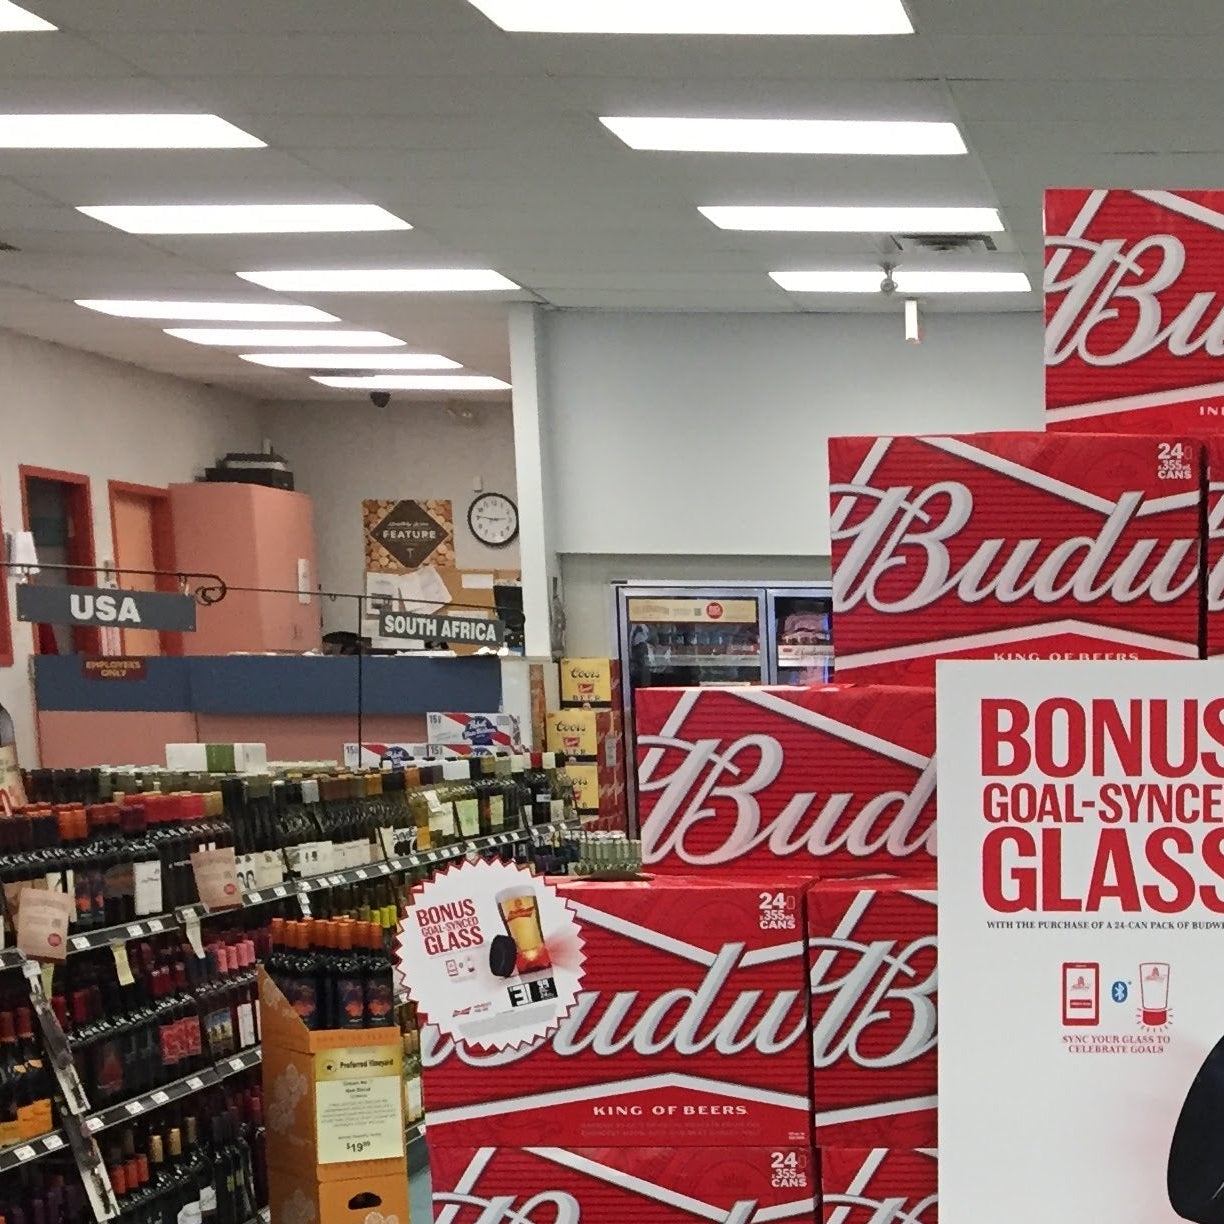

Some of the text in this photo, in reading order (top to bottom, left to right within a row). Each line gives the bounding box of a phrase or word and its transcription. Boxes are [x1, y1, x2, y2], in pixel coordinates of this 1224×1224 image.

[1158, 443, 1184, 459] 24
[1158, 471, 1191, 479] CANS
[70, 594, 141, 622] USA
[384, 614, 497, 642] SOUTH AFRICA
[760, 893, 786, 910] 24
[416, 899, 476, 927] BONUS
[421, 916, 479, 937] GOAL-SYNCED
[760, 920, 796, 930] CANS
[987, 921, 1013, 930] WITH
[1016, 921, 1036, 930] THE
[1038, 921, 1089, 930] PURCHASE
[1091, 921, 1104, 930] OF
[1106, 921, 1113, 930] A
[1150, 921, 1175, 930] PACK
[1176, 921, 1190, 930] OF
[424, 927, 484, 956] GLASS
[1062, 1035, 1170, 1044] SYNC YOUR GLASS TO
[1068, 1045, 1164, 1054] CELEBRATE GOALS
[593, 1106, 747, 1116] KING OF BEERS
[771, 1152, 797, 1168] 24
[771, 1178, 806, 1187] CANS
